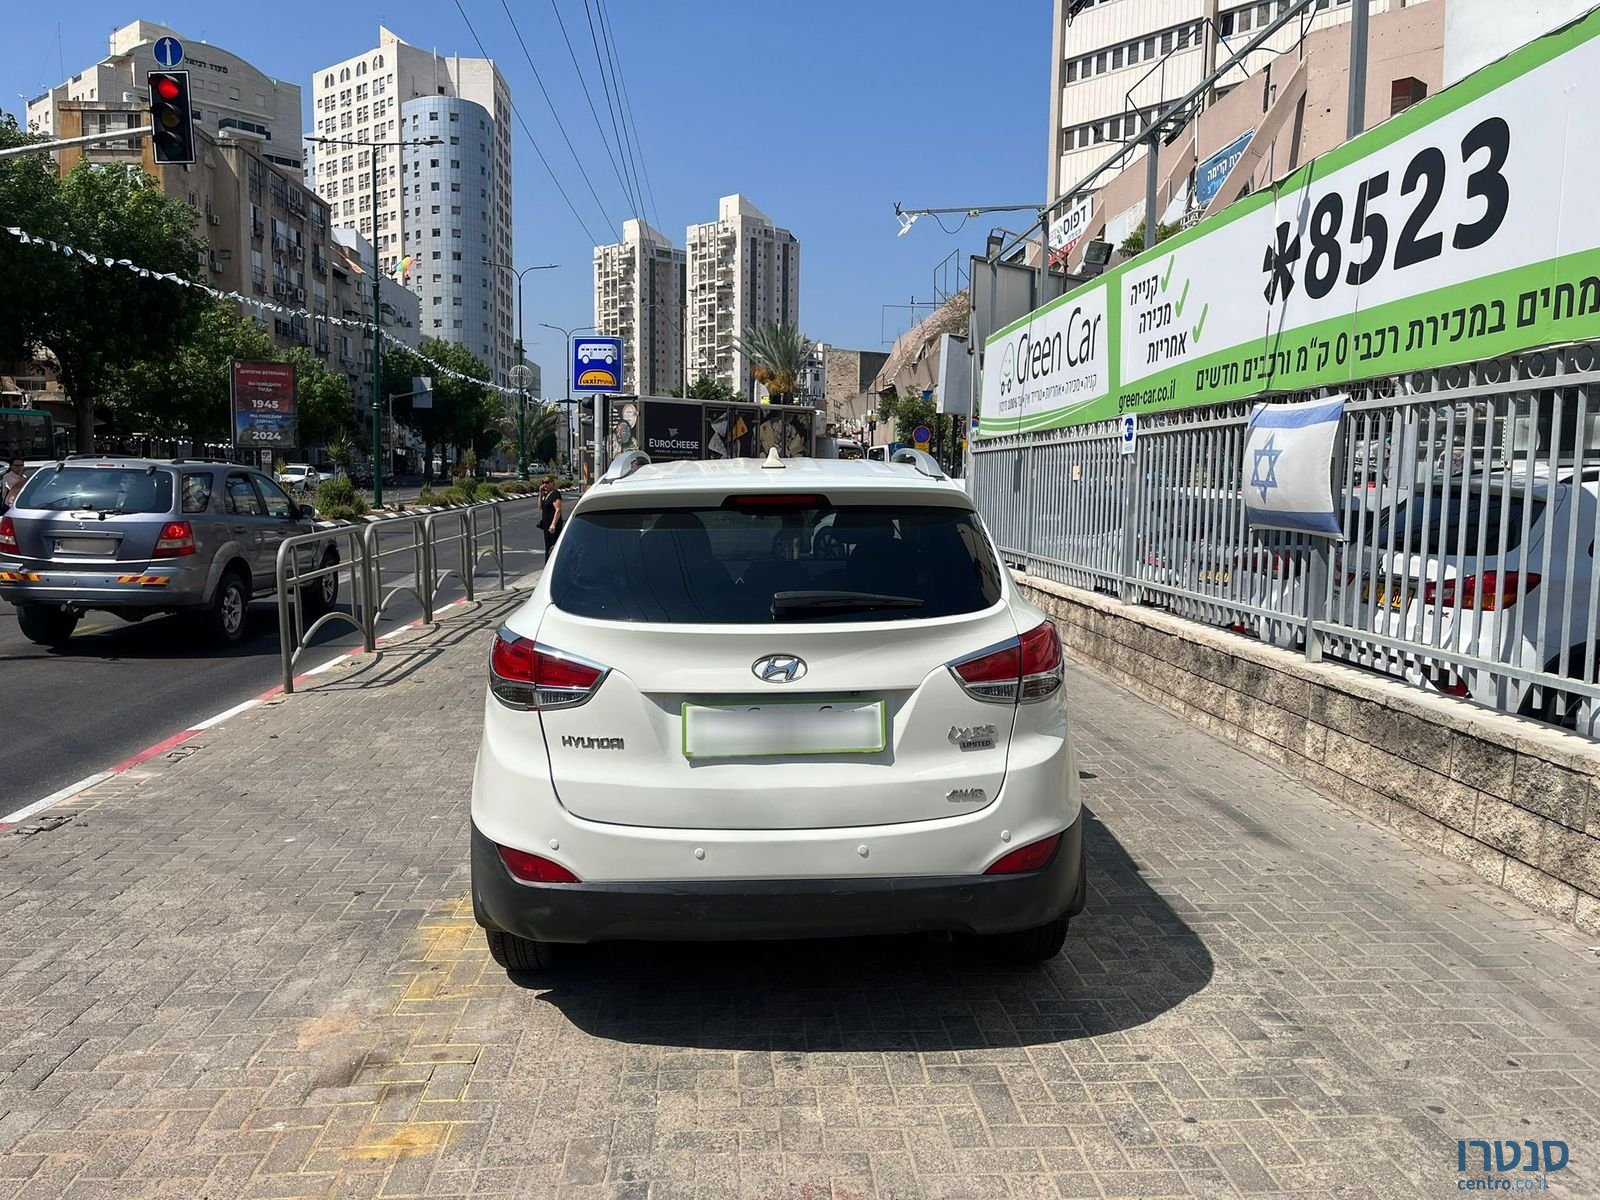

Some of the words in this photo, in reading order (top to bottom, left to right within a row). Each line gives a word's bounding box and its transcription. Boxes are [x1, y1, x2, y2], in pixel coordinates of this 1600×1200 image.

[1207, 159, 1228, 181] קדימה
[1063, 205, 1087, 235] דפוס
[1131, 274, 1159, 306] קנייה
[1139, 302, 1172, 334] מכירה
[1406, 299, 1506, 351] במכירת
[1017, 333, 1062, 385] Green
[1067, 307, 1101, 368] Car
[1147, 331, 1187, 364] אחריות
[1336, 332, 1348, 366] 0
[1354, 325, 1399, 361] רכבי
[1196, 362, 1239, 391] חדשים
[1243, 350, 1291, 382] ורכבים
[252, 400, 279, 409] 1945
[1118, 378, 1176, 413] green-car.co.il
[252, 431, 281, 440] 2024
[649, 438, 699, 449] EUROCHEESE
[561, 735, 624, 750] HYUNDAI
[962, 740, 991, 749] LIMITED
